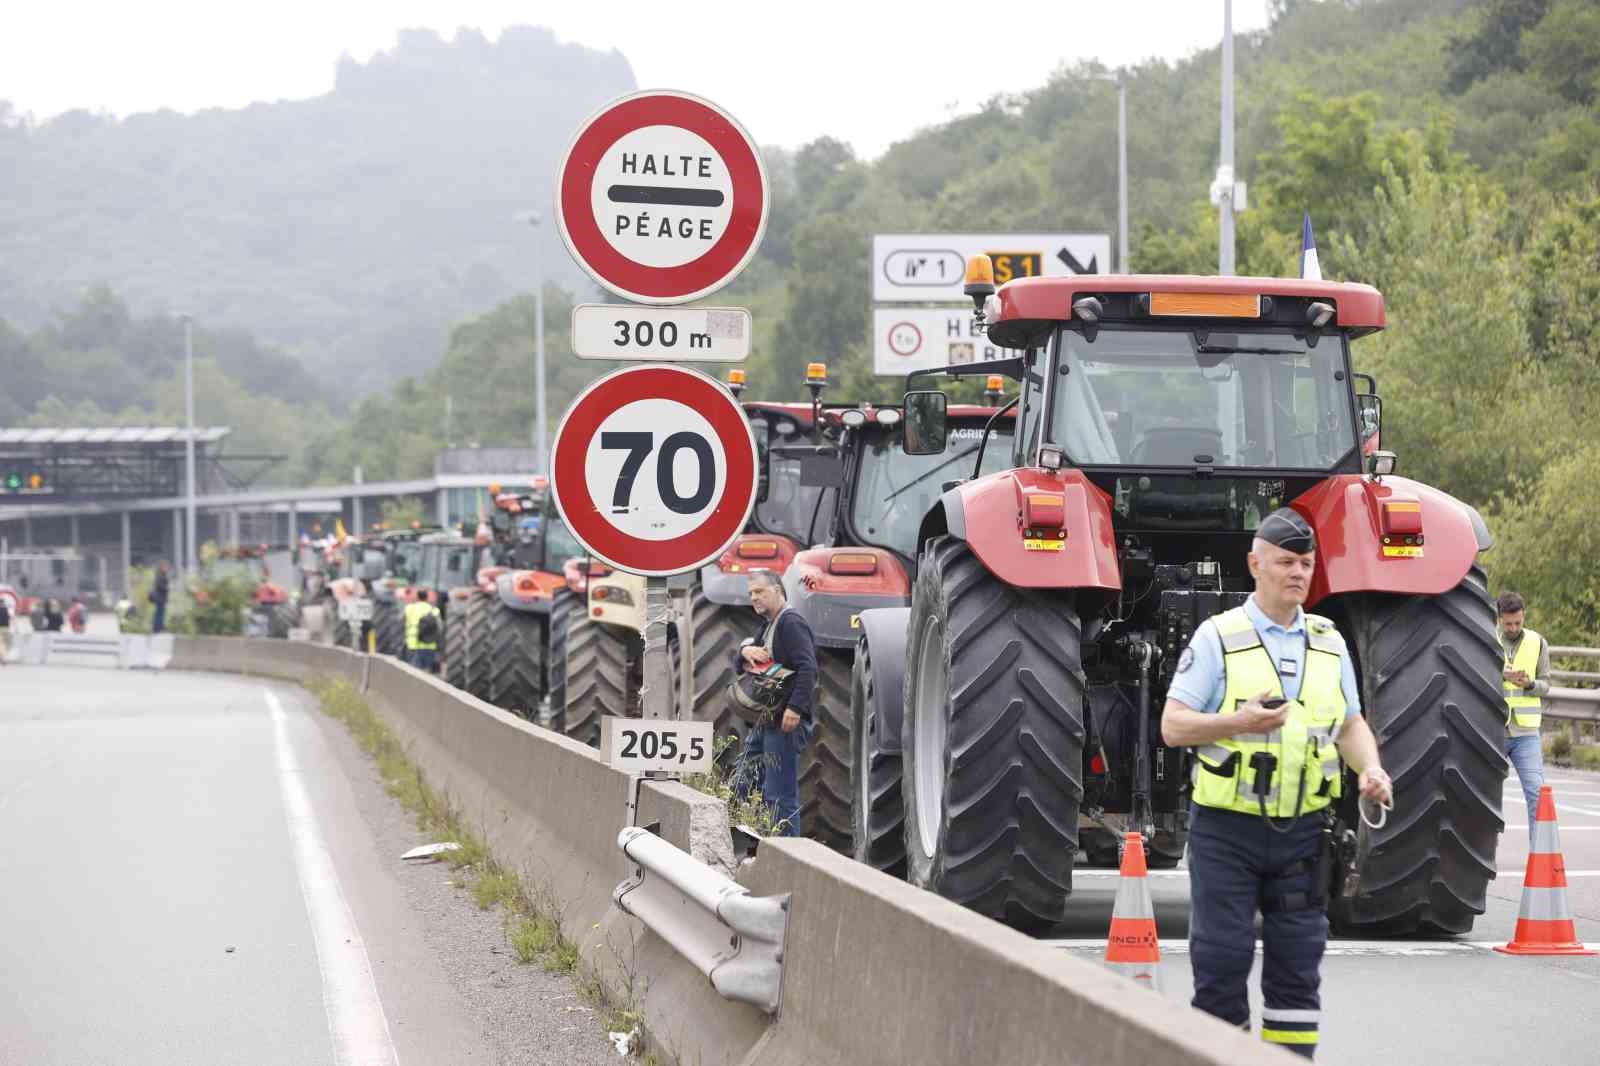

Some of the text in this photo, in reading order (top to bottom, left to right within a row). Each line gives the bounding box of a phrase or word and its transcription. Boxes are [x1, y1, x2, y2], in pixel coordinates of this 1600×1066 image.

[621, 153, 713, 178] HALTE
[615, 211, 713, 240] PÉAGE
[938, 260, 945, 277] 1
[613, 320, 712, 348] 300 m
[947, 319, 981, 337] HE
[601, 431, 716, 515] 70
[620, 730, 705, 764] 205,5
